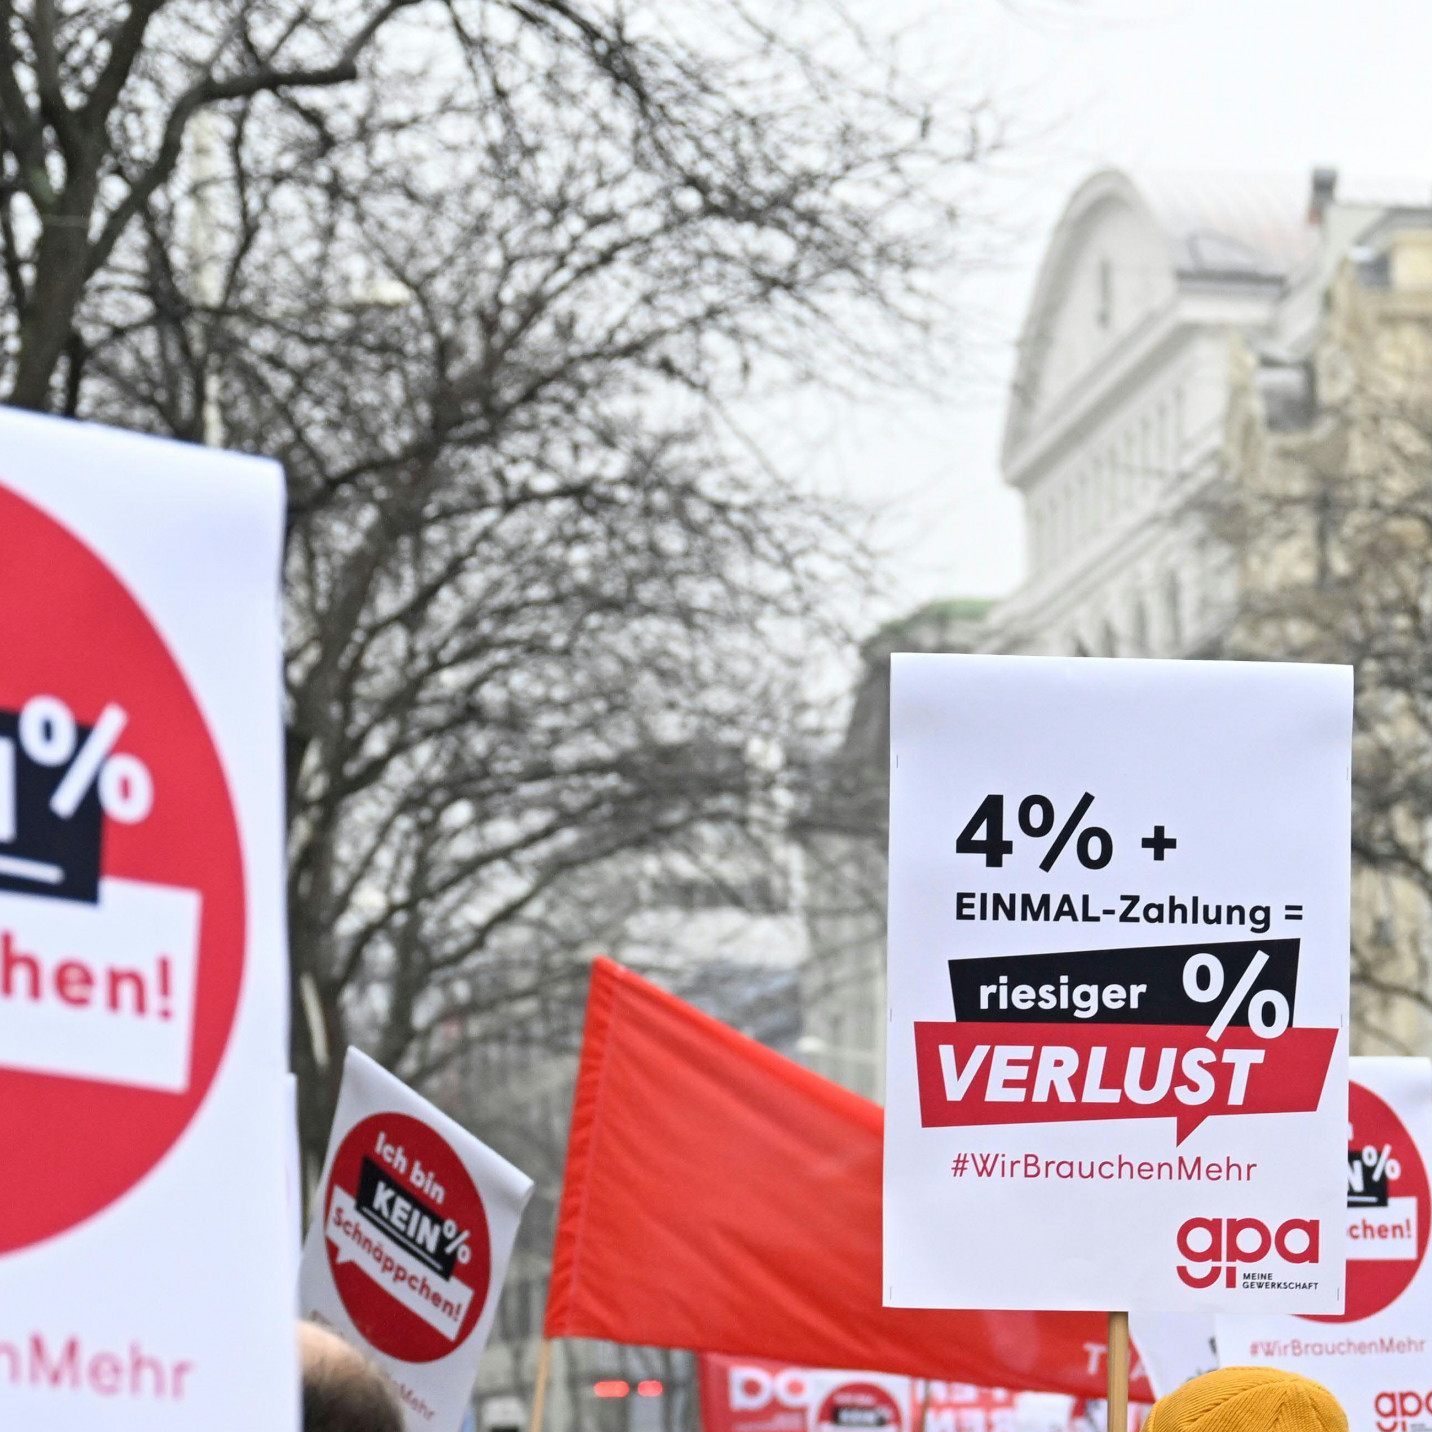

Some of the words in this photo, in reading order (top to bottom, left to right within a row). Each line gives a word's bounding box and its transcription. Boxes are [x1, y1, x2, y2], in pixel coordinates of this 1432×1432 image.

[955, 791, 1114, 873] 4%
[1141, 825, 1178, 861] +
[955, 892, 1272, 934] EINMAL-Zahlung
[979, 976, 1148, 1019] riesiger
[1182, 950, 1290, 1043] %
[938, 1044, 1266, 1107] VERLUST
[374, 1131, 408, 1174] Ich
[409, 1160, 446, 1205] bin
[951, 1153, 1258, 1182] #WirBrauchenMehr
[1348, 1145, 1402, 1194] N%
[372, 1180, 472, 1265] KEIN%
[1176, 1217, 1320, 1289] gpa
[1347, 1218, 1412, 1240] chen!
[333, 1206, 463, 1322] Schnäppchen!
[1242, 1273, 1274, 1281] MEINE
[1242, 1281, 1319, 1291] GEWERKSCHAFT
